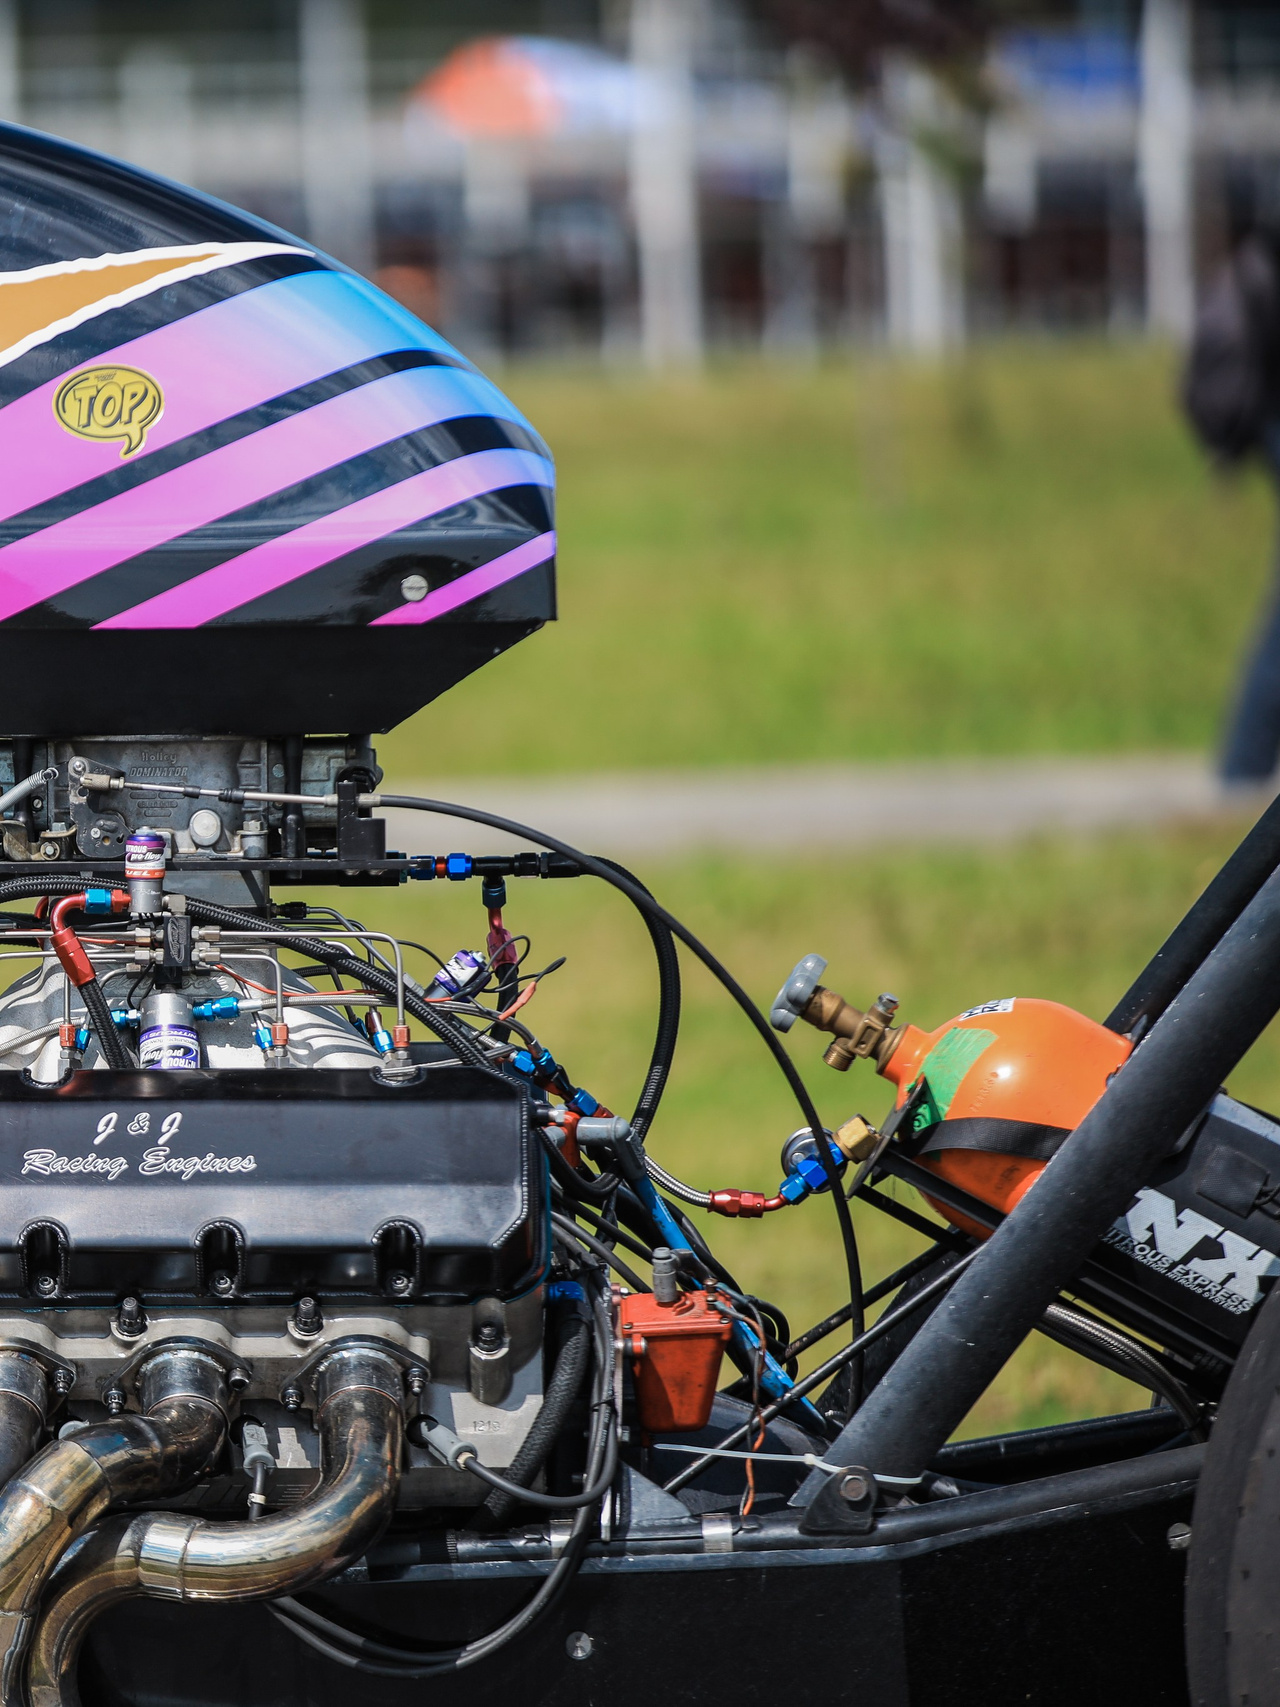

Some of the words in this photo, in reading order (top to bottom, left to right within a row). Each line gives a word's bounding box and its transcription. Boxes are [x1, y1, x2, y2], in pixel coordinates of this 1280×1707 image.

[73, 380, 149, 430] TOP
[129, 767, 189, 777] DOMINATOR
[93, 1111, 119, 1145] J
[126, 1112, 151, 1135] &
[157, 1111, 183, 1145] J
[21, 1148, 130, 1180] Racing
[138, 1146, 258, 1180] Engines
[1126, 1188, 1277, 1303] NX
[1171, 1264, 1255, 1312] EXPRESS
[1202, 1291, 1244, 1315] SYSTEMS
